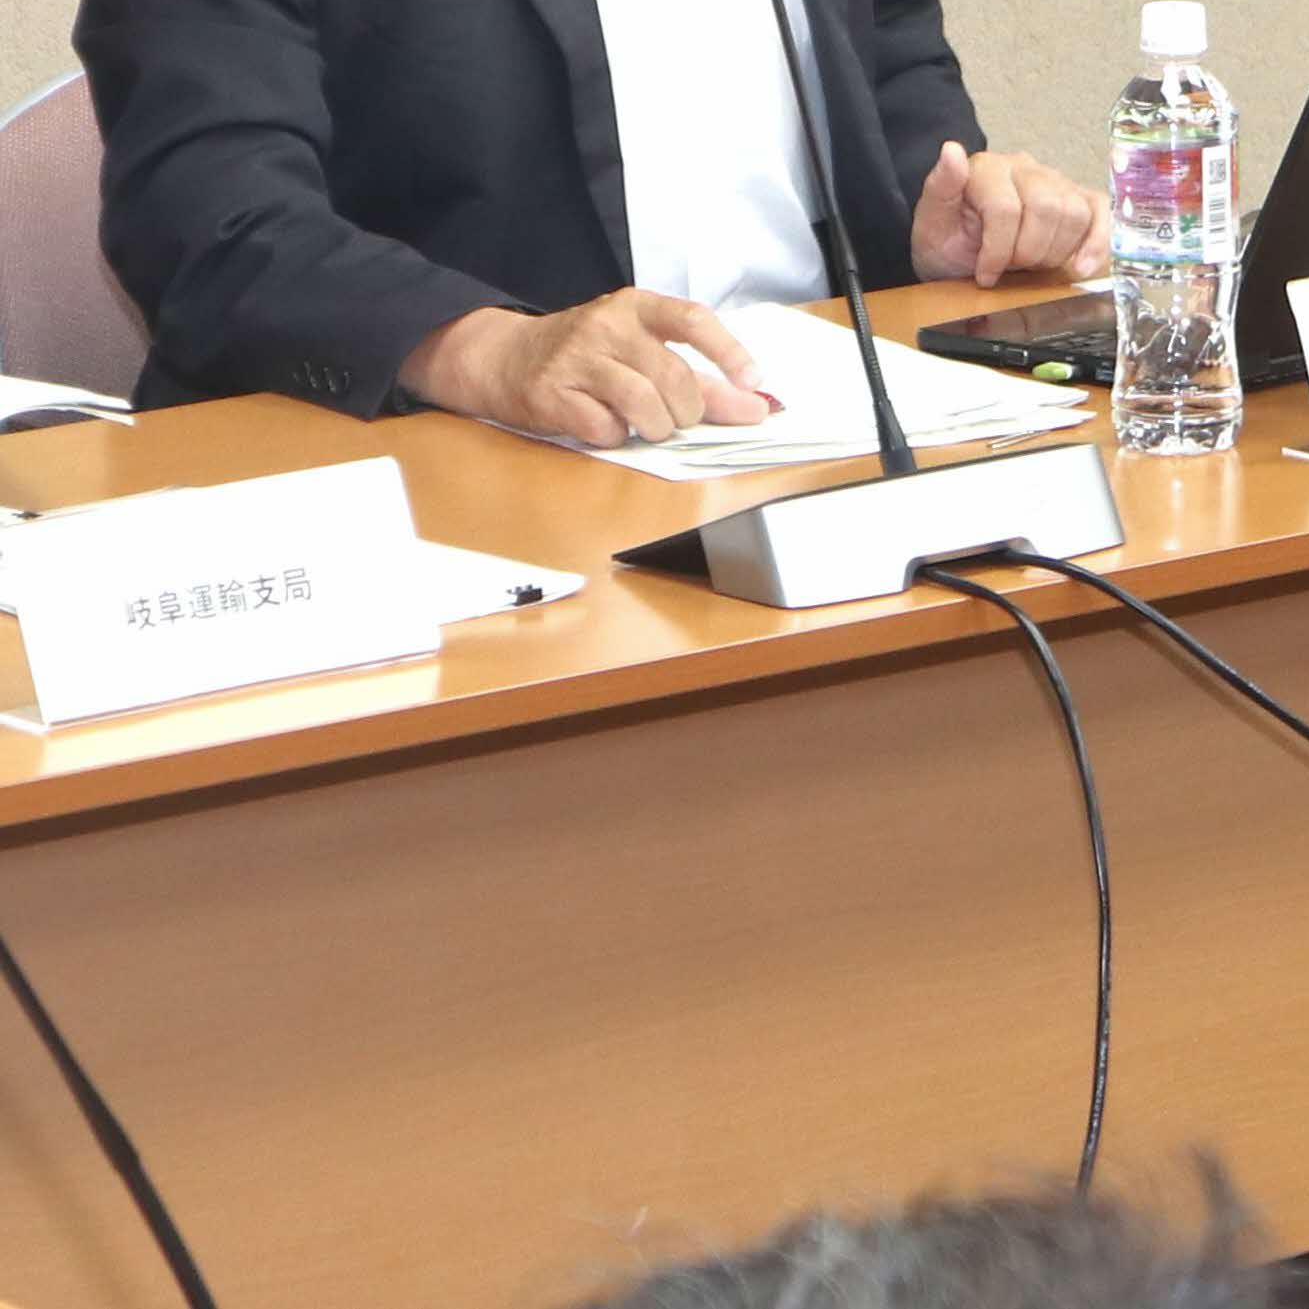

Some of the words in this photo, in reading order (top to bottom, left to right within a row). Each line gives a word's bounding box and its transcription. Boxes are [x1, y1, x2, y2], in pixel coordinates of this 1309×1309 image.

[126, 566, 313, 630] 岐阜運輸支局
